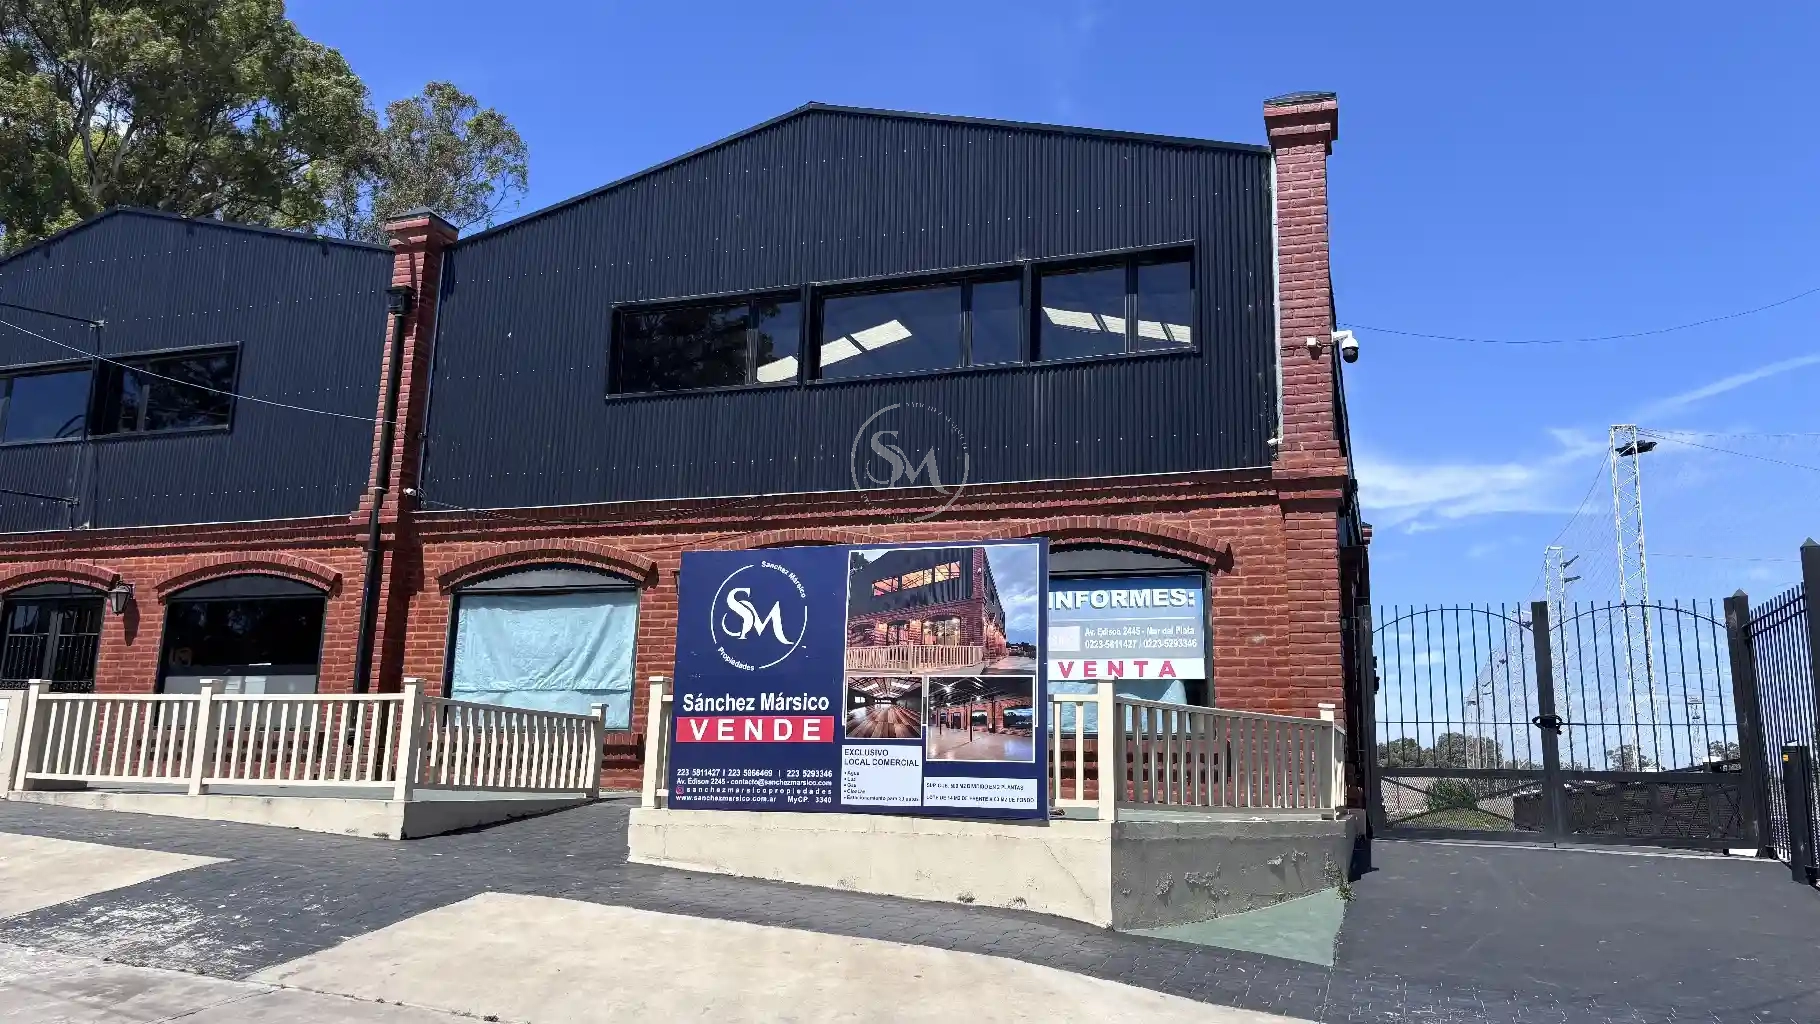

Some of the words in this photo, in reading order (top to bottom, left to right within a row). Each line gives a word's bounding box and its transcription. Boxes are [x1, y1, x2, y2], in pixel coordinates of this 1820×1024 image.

[721, 587, 795, 645] SM
[1057, 660, 1177, 679] VENTA
[682, 693, 756, 712] Sánchez
[760, 692, 830, 711] Mársico
[689, 718, 821, 741] VENDE
[844, 748, 889, 756] EXCLUSIVO
[844, 758, 870, 766] LOCAL
[872, 758, 920, 767] COMERCIAL
[676, 768, 690, 776] 223
[728, 769, 741, 777] 223
[786, 769, 800, 778] 223
[802, 769, 833, 778] 5293346
